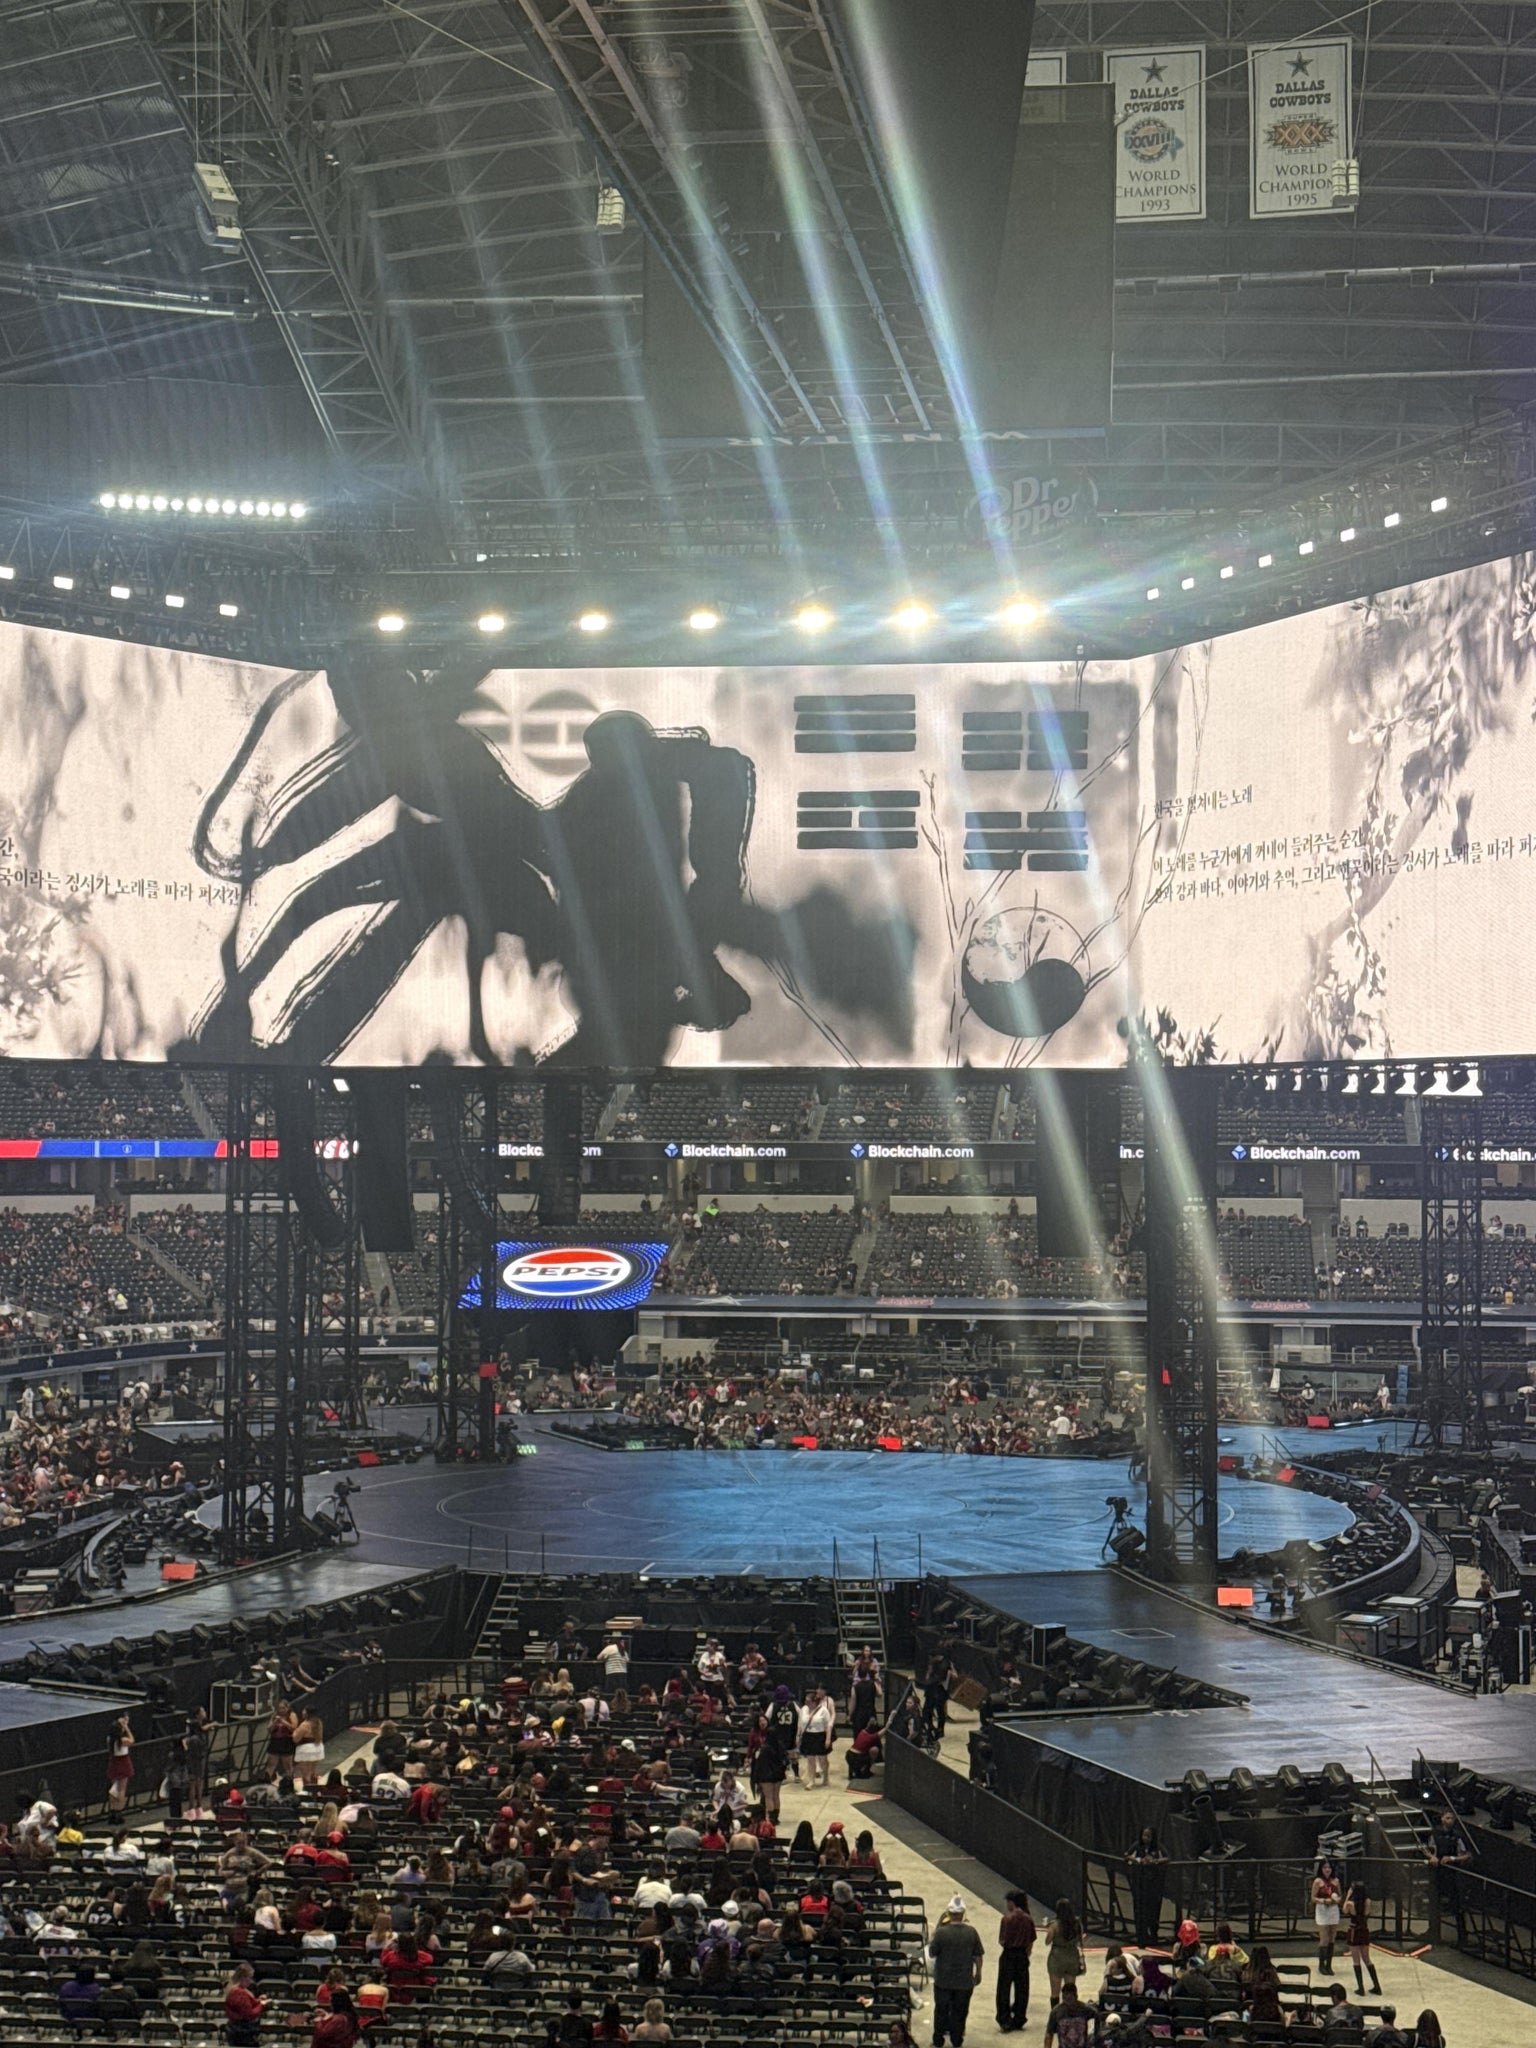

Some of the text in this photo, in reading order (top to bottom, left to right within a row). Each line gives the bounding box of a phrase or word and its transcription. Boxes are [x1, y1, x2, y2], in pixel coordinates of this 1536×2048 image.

[1129, 86, 1180, 100] DALLAS
[1275, 79, 1326, 94] DALLAS
[1123, 99, 1186, 114] COWBOYS
[1269, 93, 1332, 108] COWBOYS
[1128, 169, 1181, 183] WORLD
[1275, 163, 1328, 177] WORLD
[1115, 183, 1197, 199] CHAMPIONS
[1259, 178, 1333, 194] CHAMPION
[1140, 199, 1171, 212] 1993
[1287, 193, 1318, 207] 1995
[1012, 476, 1060, 512] Dr
[65, 872, 110, 895] 정서가
[114, 878, 160, 899] 노래를
[164, 880, 194, 901] 따라
[681, 1143, 787, 1157] Blockchain.com
[867, 1144, 975, 1158] Blockchain.com
[1250, 1145, 1361, 1161] Blockchain.com
[511, 1266, 622, 1277] PEPSI
